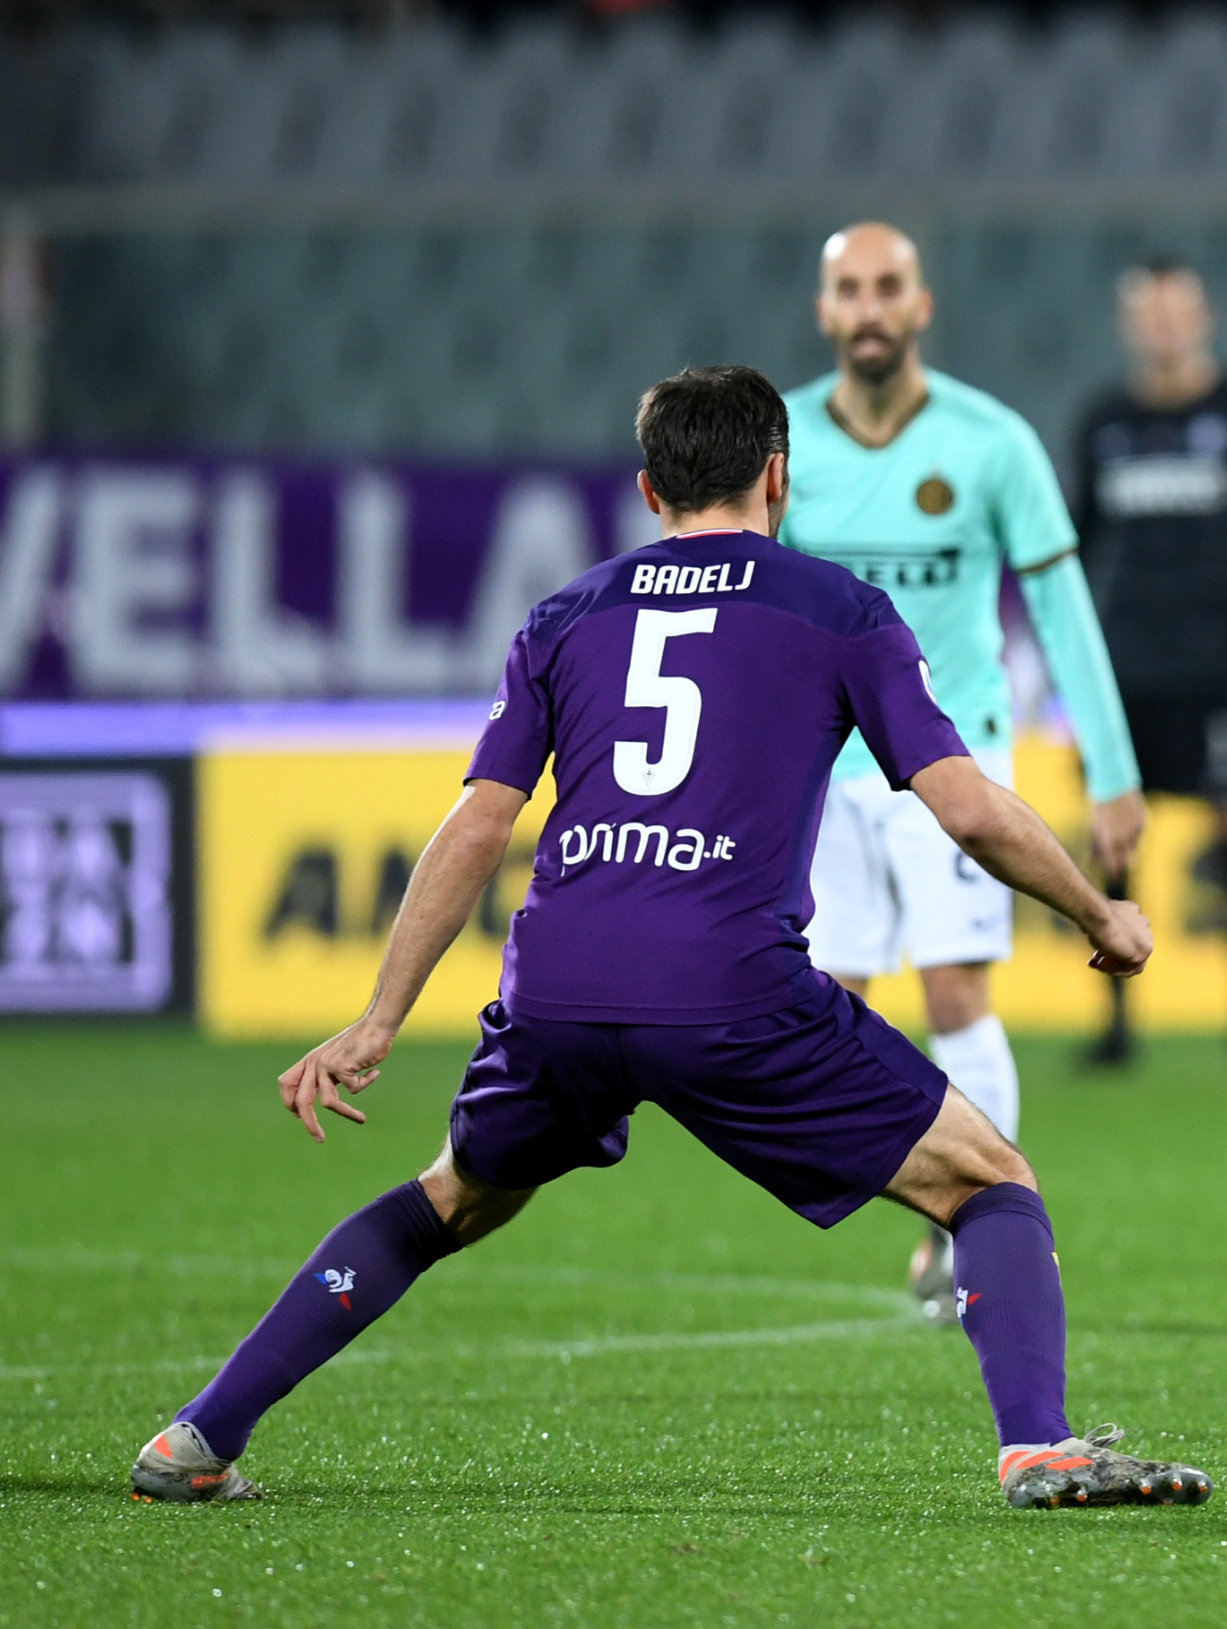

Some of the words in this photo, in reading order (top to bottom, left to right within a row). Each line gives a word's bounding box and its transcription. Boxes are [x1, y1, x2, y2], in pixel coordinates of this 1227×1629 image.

[630, 560, 755, 594] BADELJ
[612, 607, 718, 796] 5
[559, 821, 736, 877] prima.it
